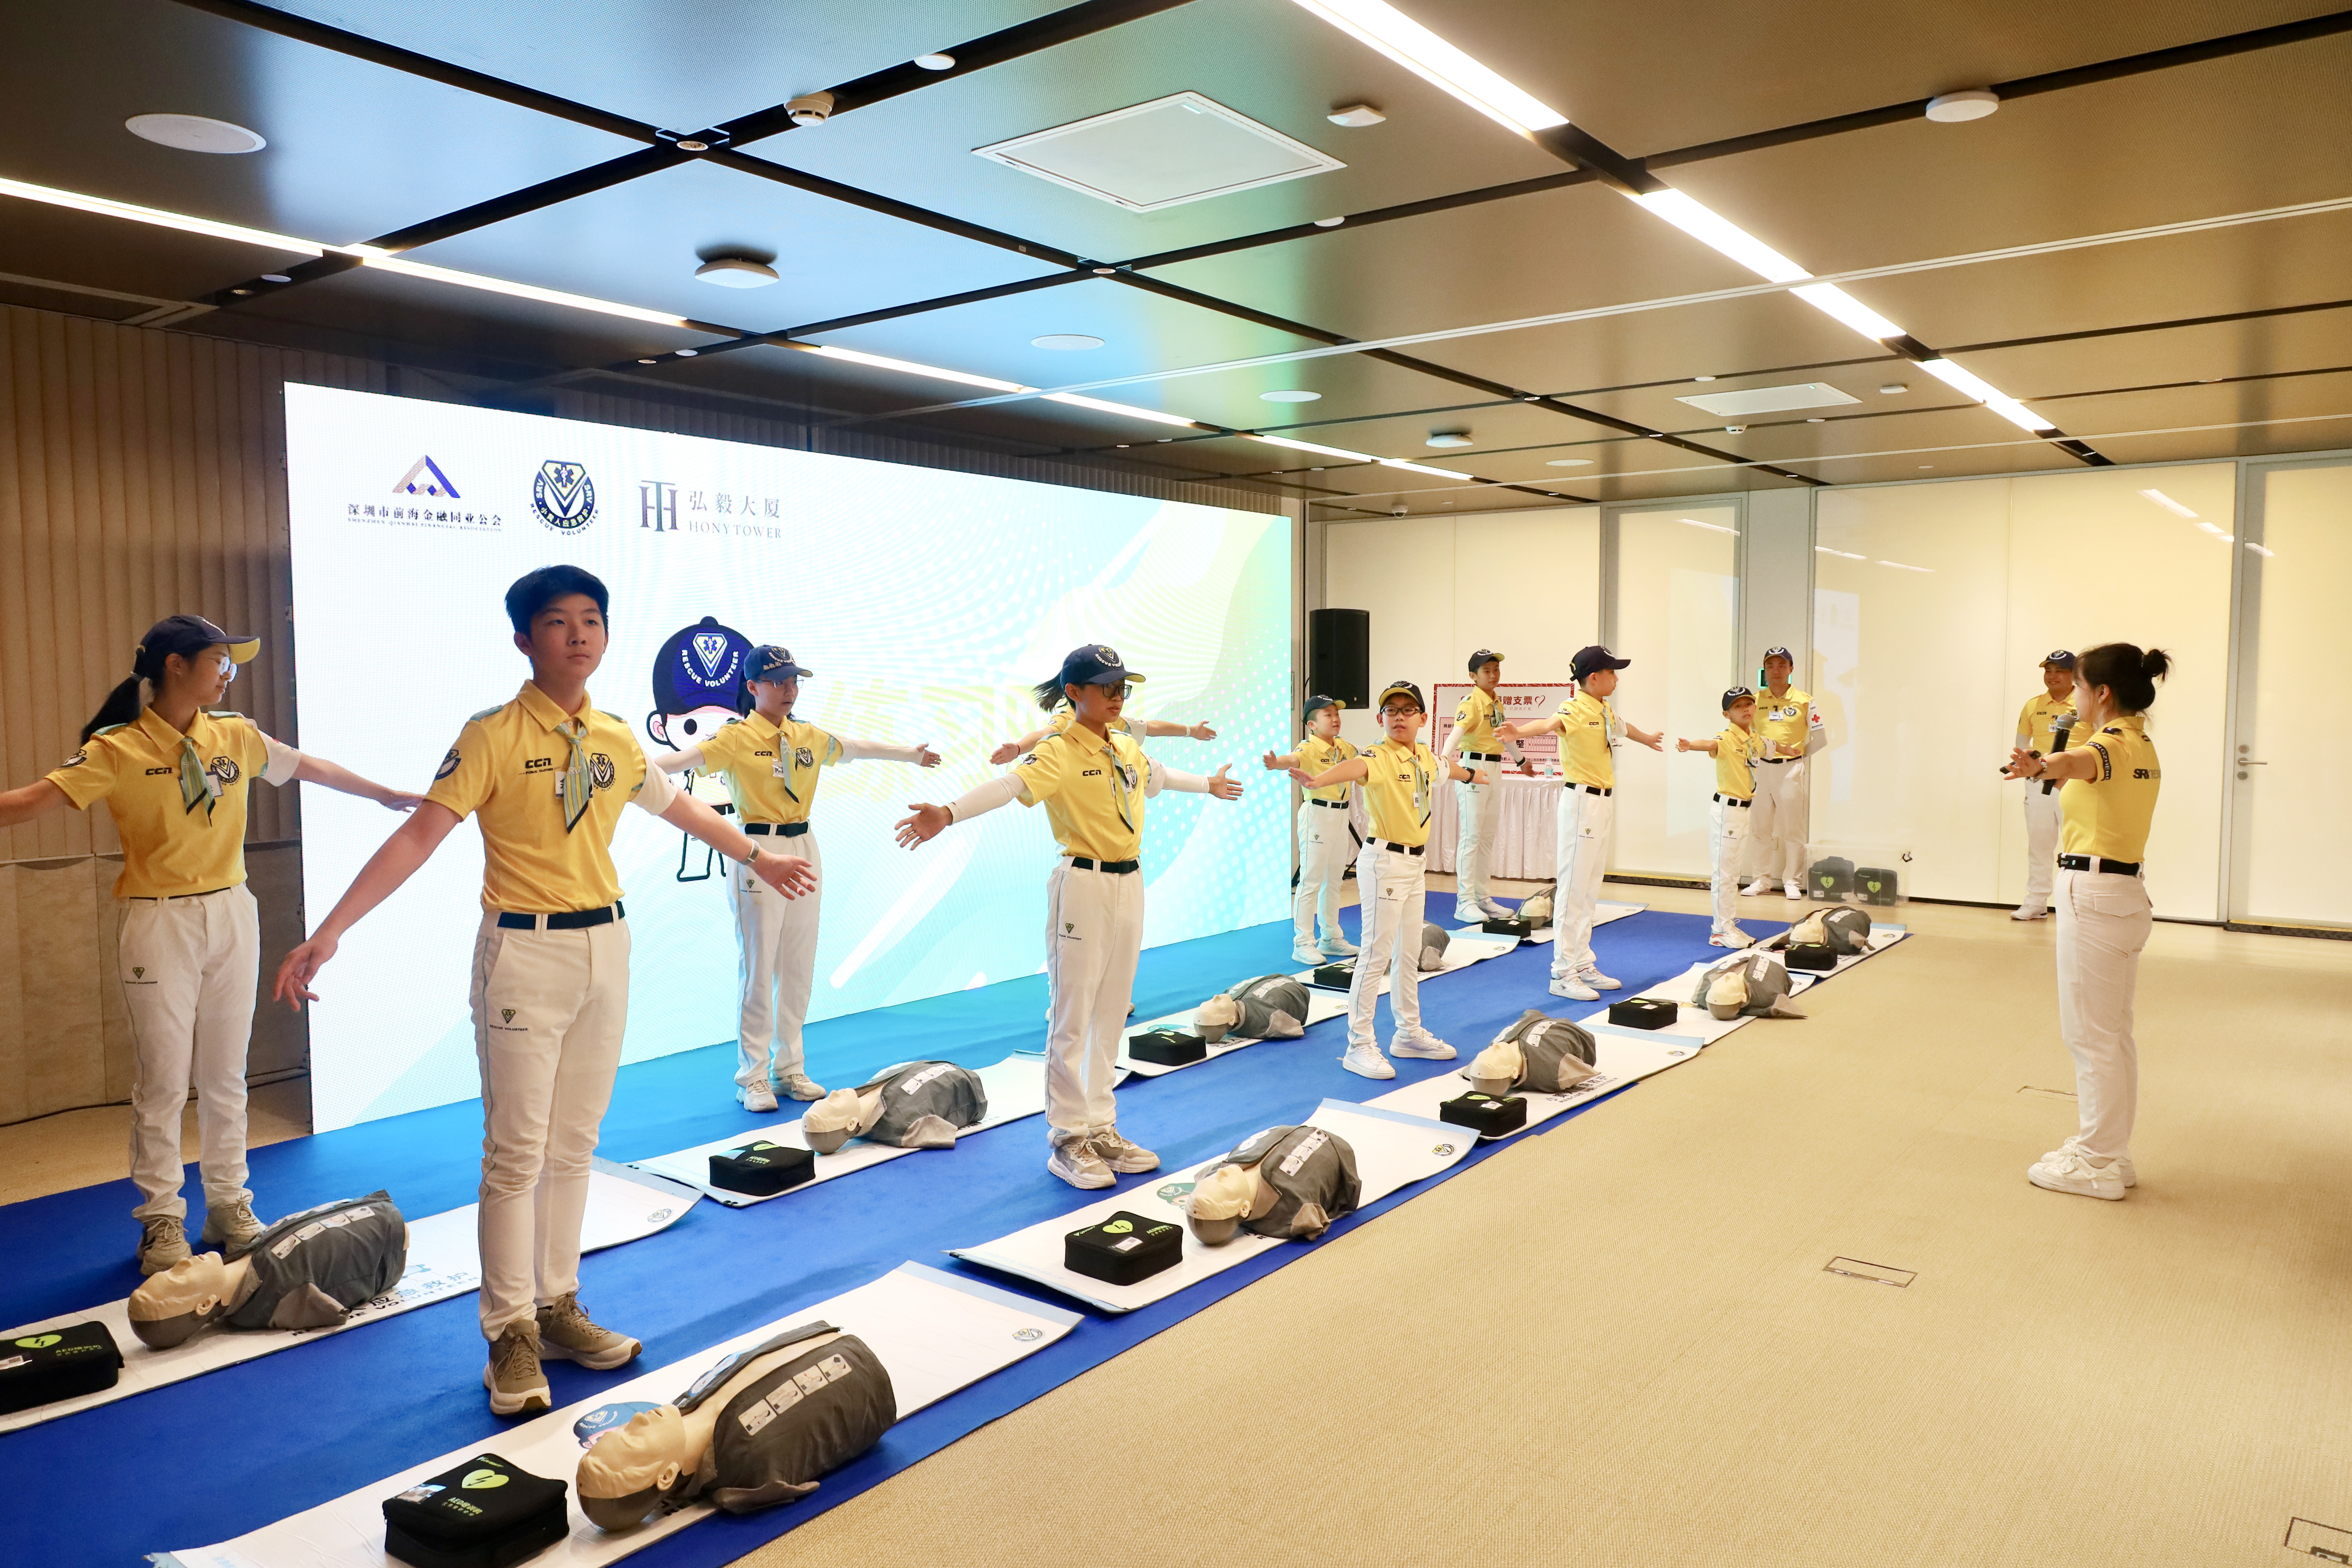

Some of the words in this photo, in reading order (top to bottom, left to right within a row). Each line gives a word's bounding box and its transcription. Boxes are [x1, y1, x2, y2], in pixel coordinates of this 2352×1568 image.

[348, 504, 502, 526] 深圳市前海金融同业公会
[689, 490, 780, 518] 弘毅大厦
[681, 649, 702, 684] RESCUE
[704, 651, 738, 687] VOLUNTEER
